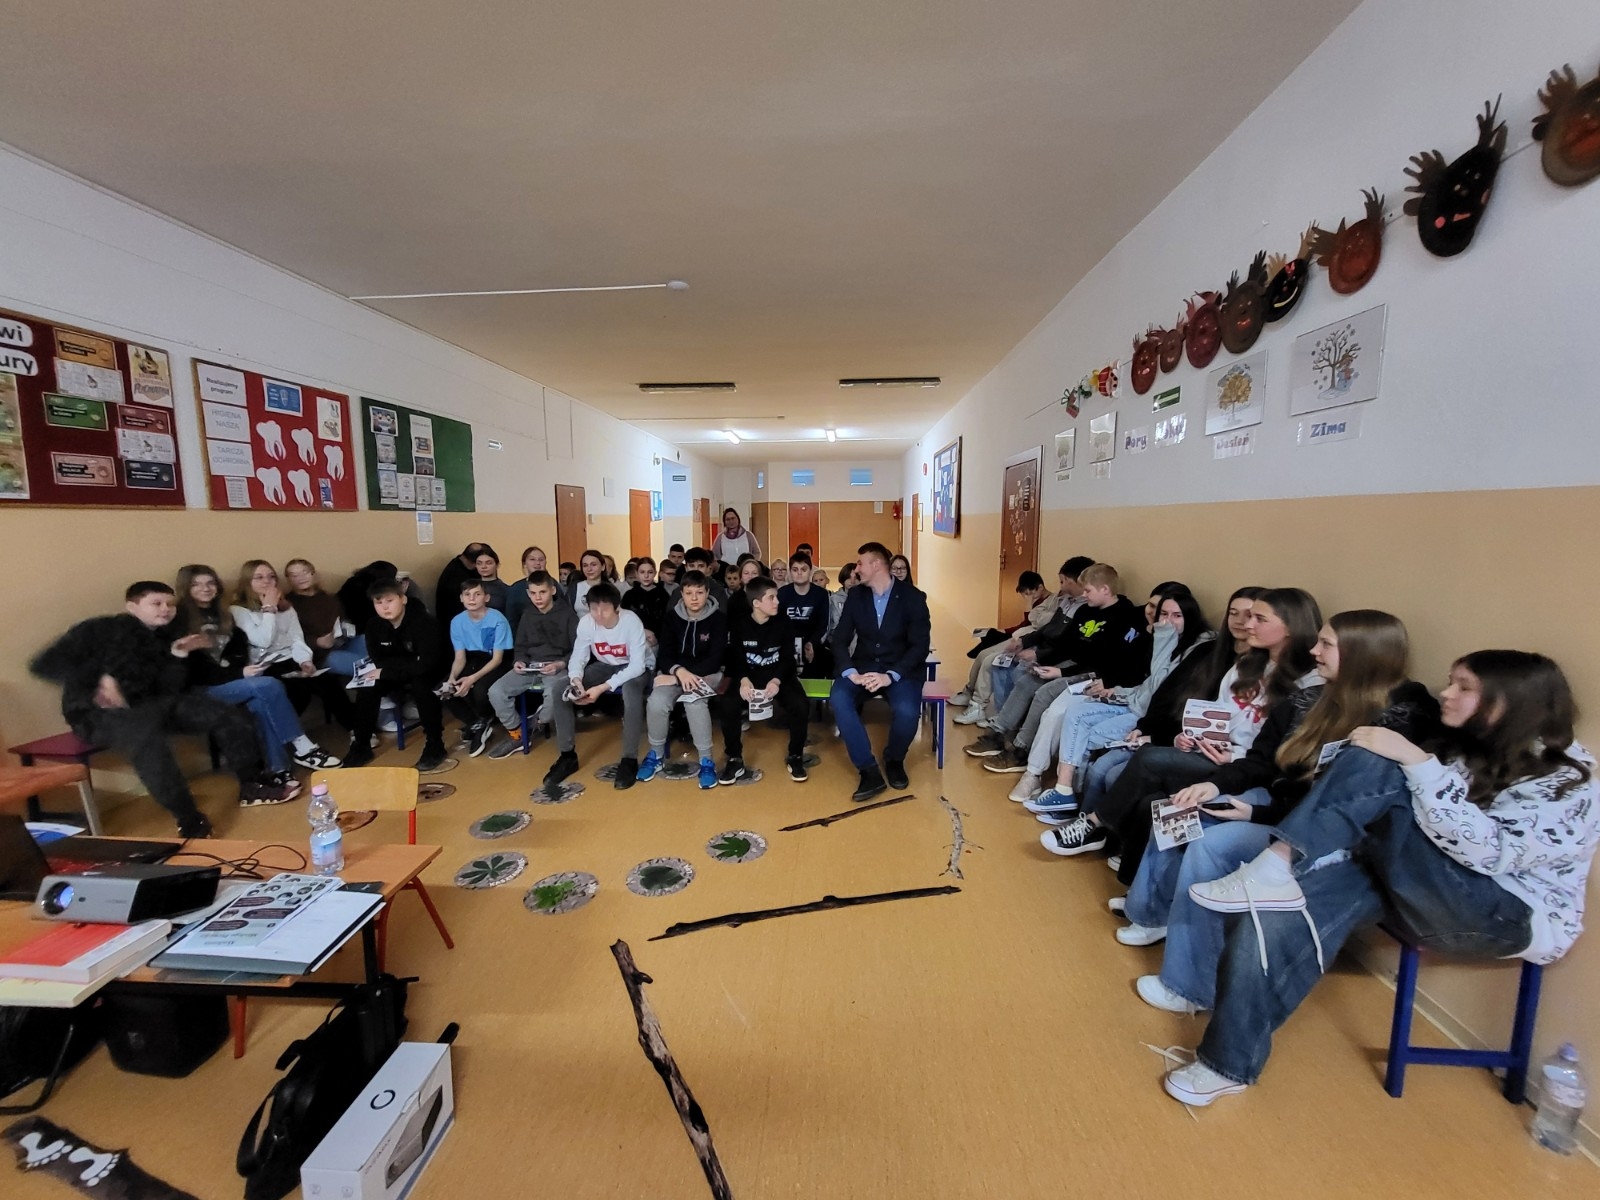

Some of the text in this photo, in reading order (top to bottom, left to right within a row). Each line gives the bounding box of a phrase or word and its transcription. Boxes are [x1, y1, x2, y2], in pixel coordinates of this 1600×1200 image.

[211, 386, 234, 396] program
[212, 409, 242, 419] HIGIENA
[1310, 421, 1346, 438] Zima
[1125, 435, 1147, 450] Pory
[786, 606, 813, 617] EA7
